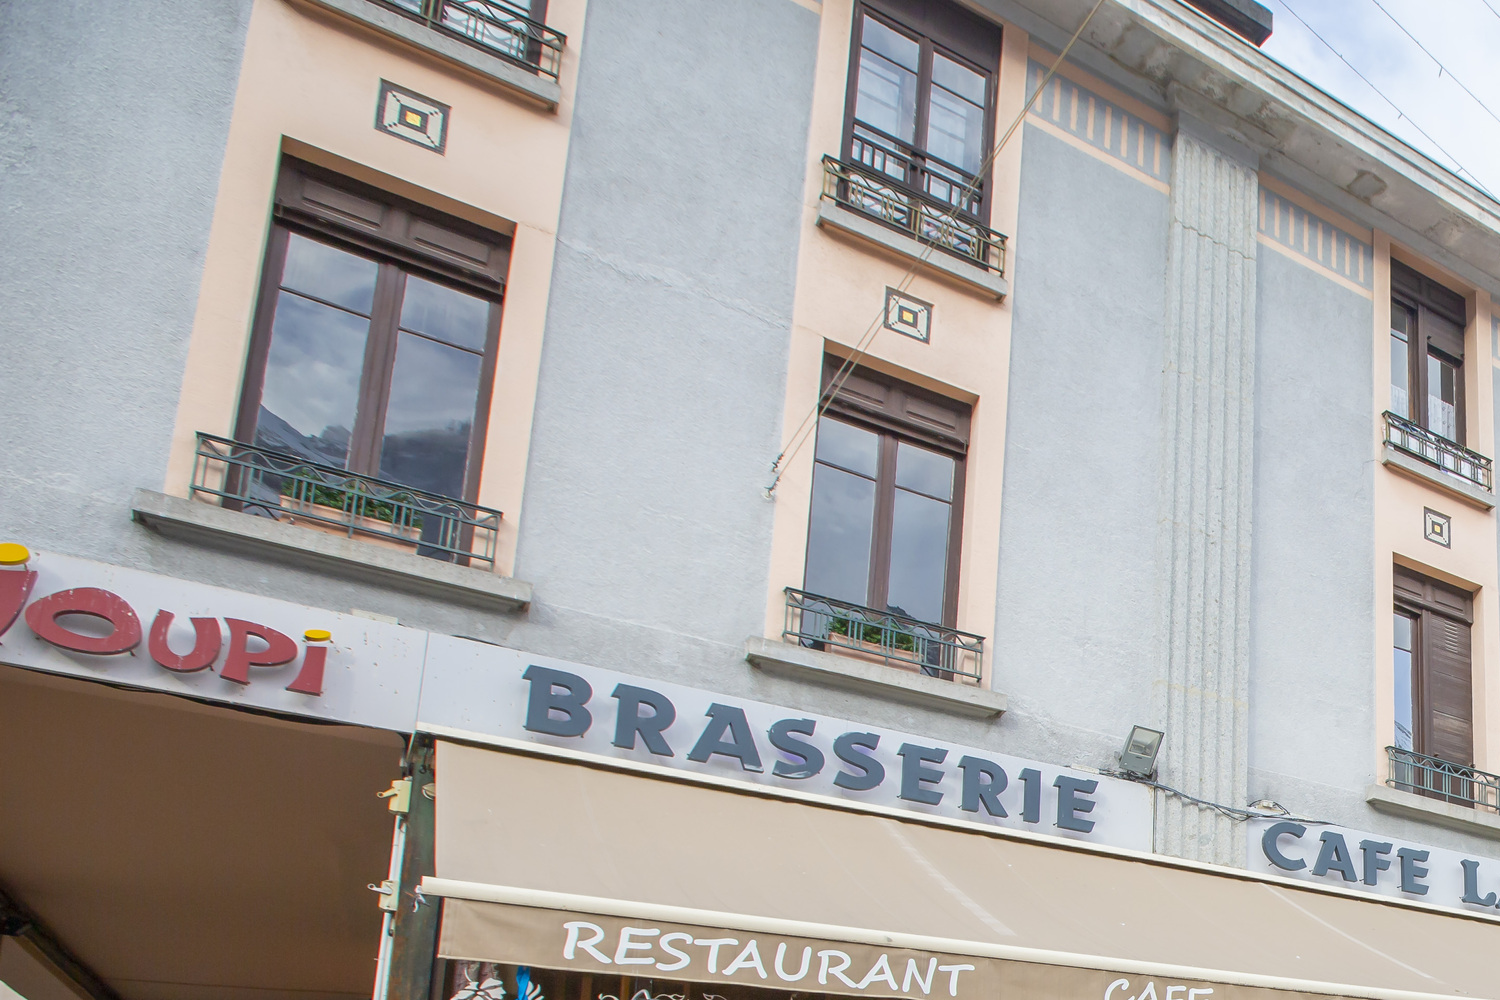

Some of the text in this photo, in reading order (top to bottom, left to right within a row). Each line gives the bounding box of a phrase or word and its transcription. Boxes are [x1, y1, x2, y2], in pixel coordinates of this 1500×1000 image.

[522, 664, 1100, 834] BRASSERIE
[1261, 821, 1431, 896] CAFE
[563, 921, 976, 997] RESTAURANT
